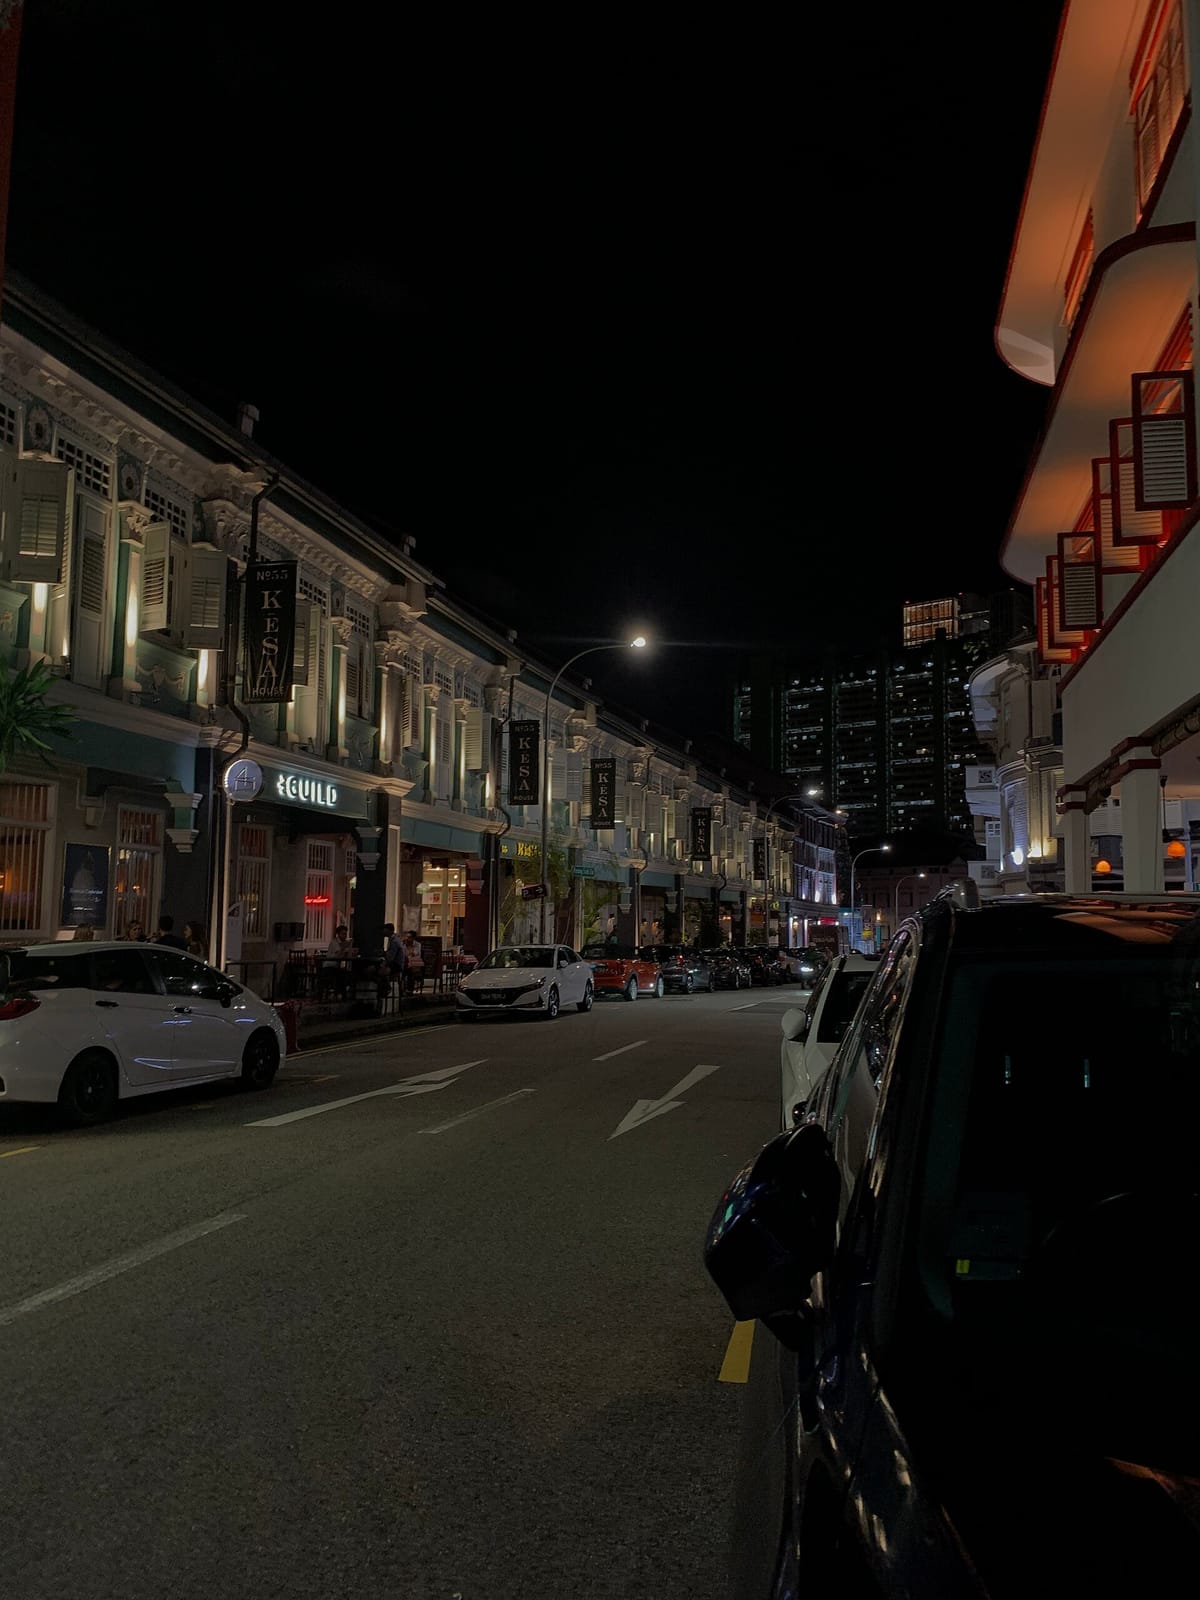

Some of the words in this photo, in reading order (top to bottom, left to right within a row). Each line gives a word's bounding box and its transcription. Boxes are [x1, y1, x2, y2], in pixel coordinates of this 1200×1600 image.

[258, 590, 283, 677] KESA
[252, 686, 285, 697] HOUSE
[519, 737, 532, 790] KESA
[285, 775, 337, 806] GUILD
[598, 773, 609, 817] KESA
